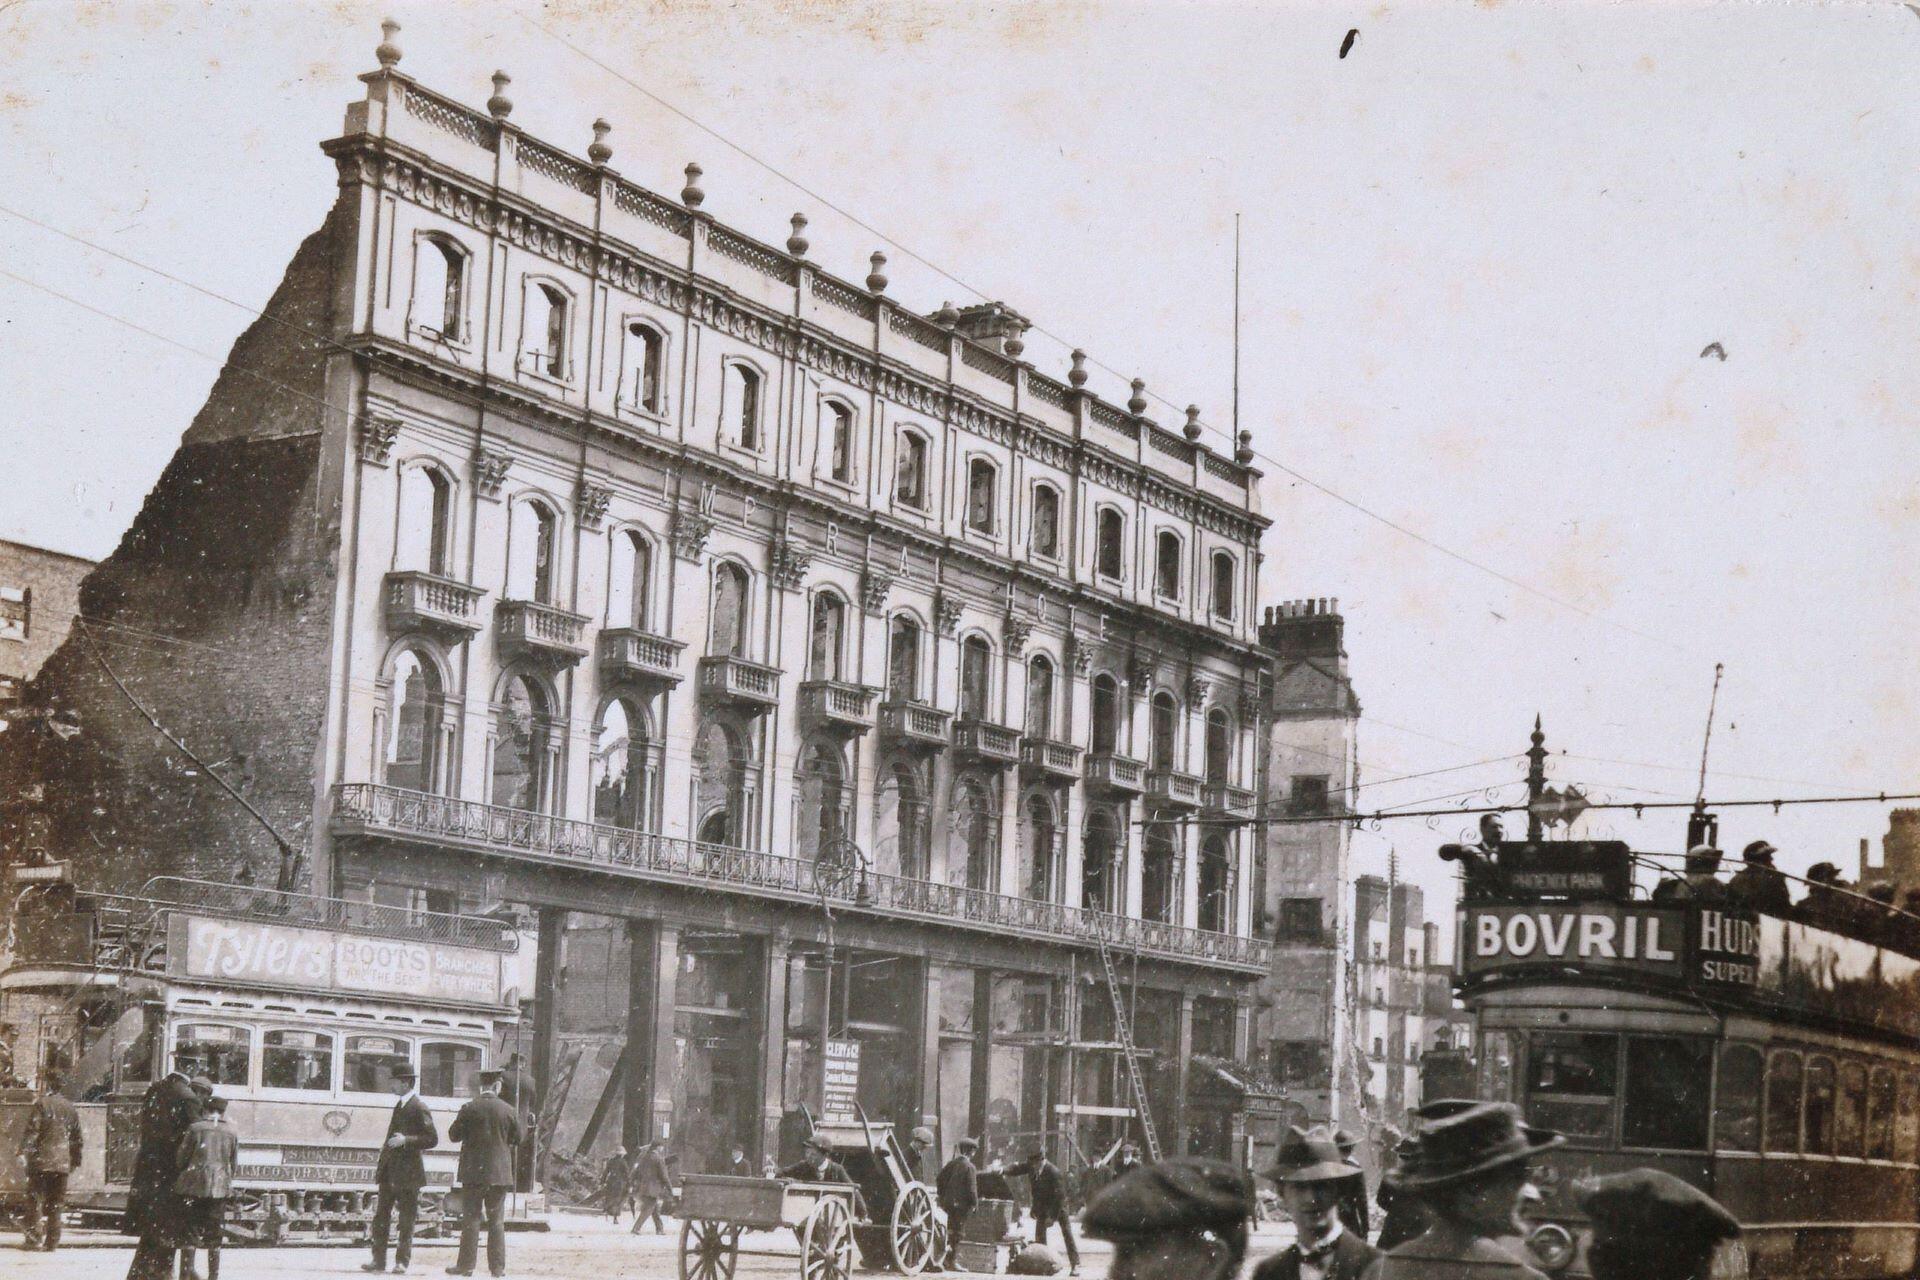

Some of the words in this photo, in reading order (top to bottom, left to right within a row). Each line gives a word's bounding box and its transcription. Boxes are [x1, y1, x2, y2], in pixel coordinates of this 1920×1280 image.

[1571, 872, 1604, 889] PARK
[1476, 913, 1675, 961] BOVRIL
[341, 941, 427, 972] BOOTS
[435, 951, 494, 976] BRANCHES
[369, 968, 391, 984] THE
[288, 1149, 364, 1163] SACKVILLE
[233, 1164, 322, 1179] UMCONDRA
